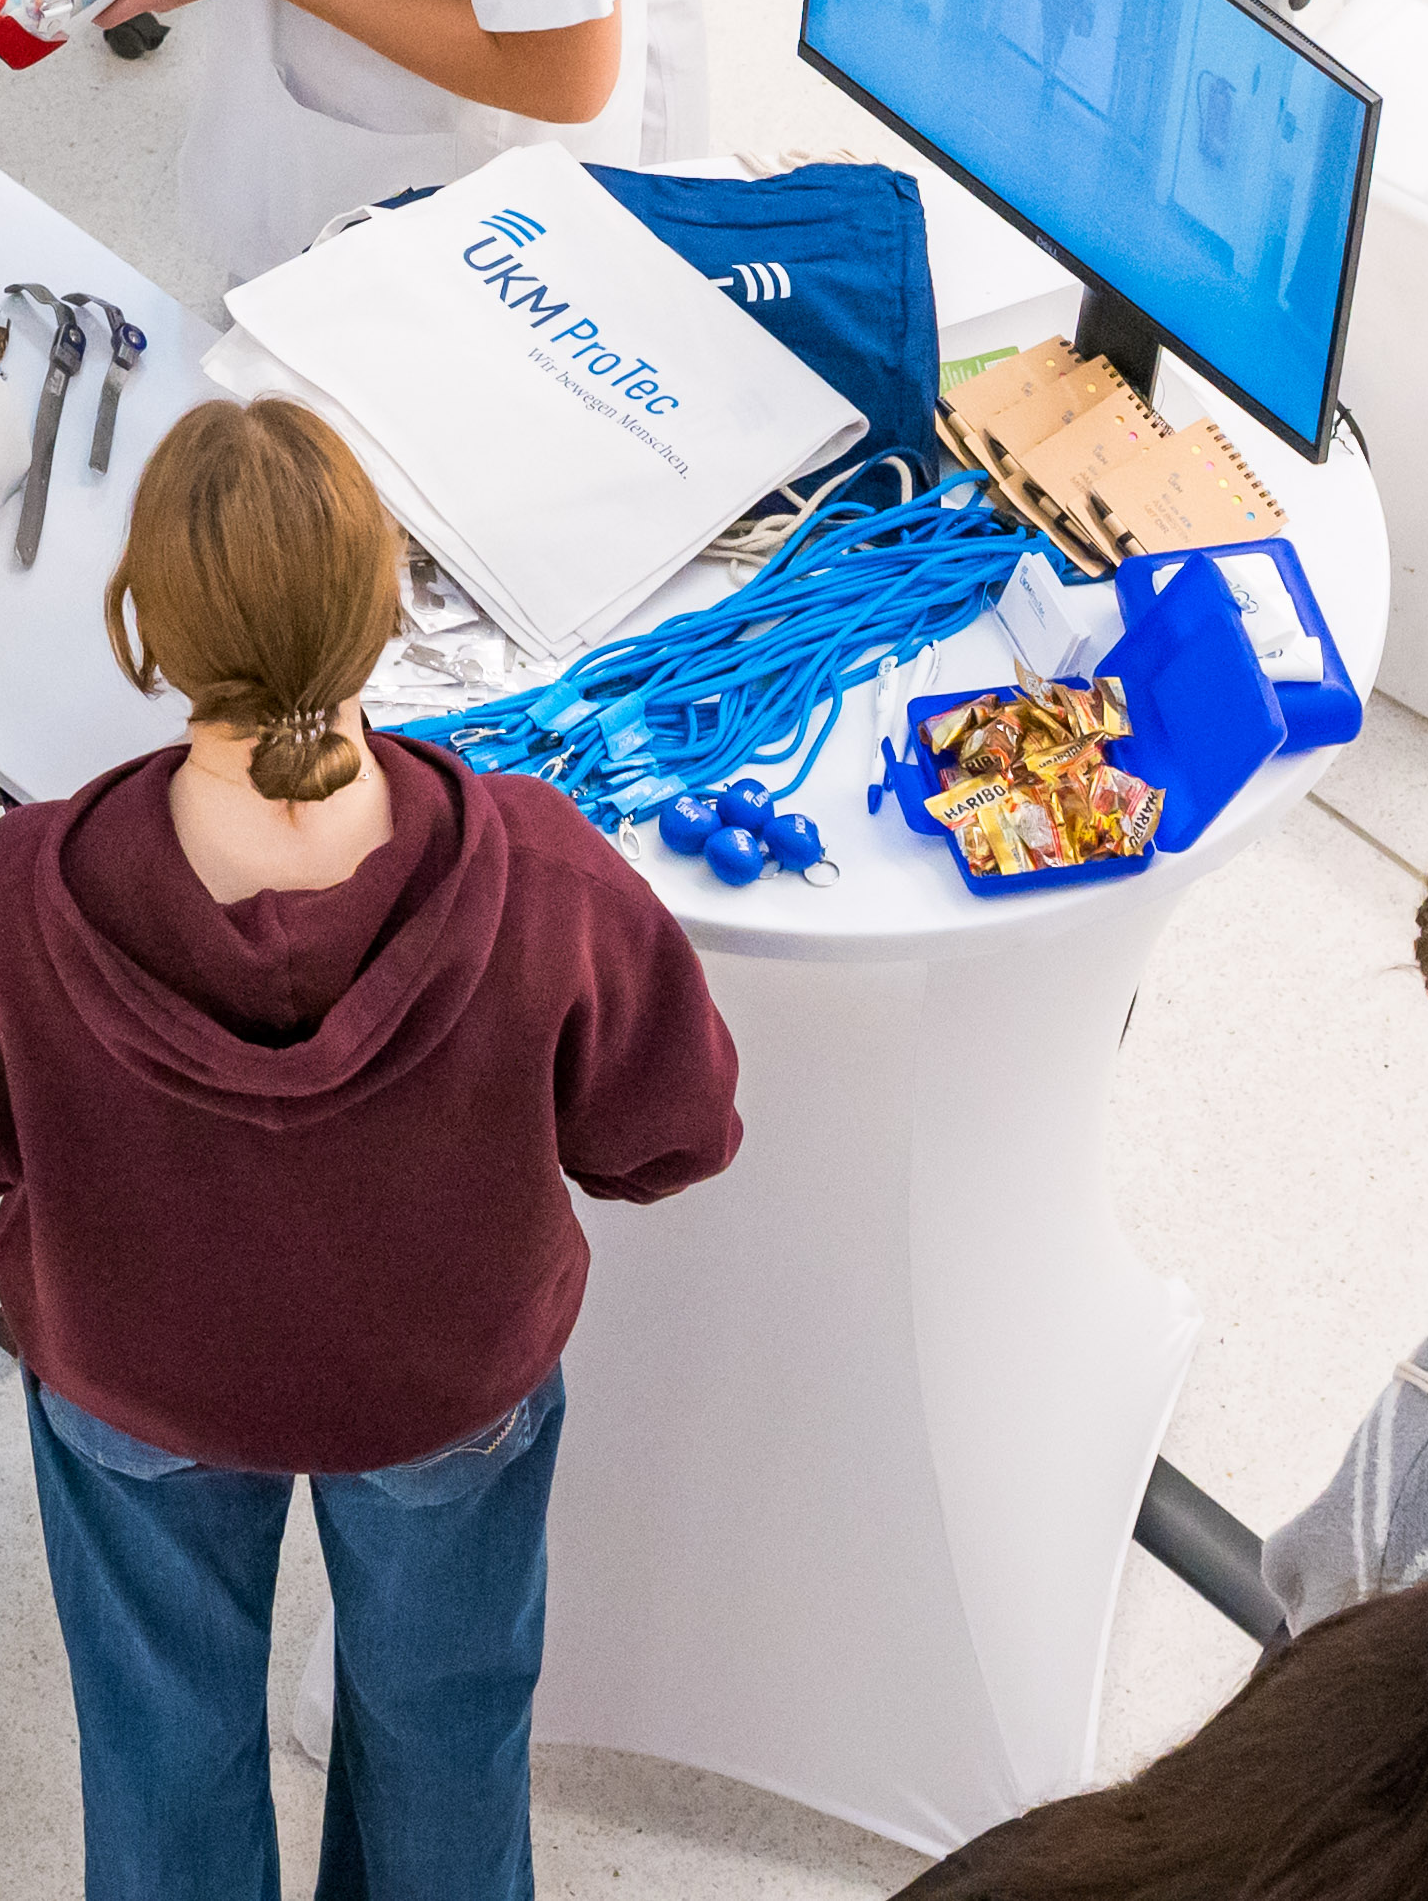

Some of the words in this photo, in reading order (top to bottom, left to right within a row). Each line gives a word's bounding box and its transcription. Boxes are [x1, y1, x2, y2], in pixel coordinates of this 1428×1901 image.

[463, 236, 570, 329] UKM
[550, 317, 680, 417] ProTec
[527, 345, 557, 375] Wir
[555, 365, 619, 420] bewegen
[616, 409, 691, 481] Menschen.
[674, 802, 701, 823] UKM
[944, 783, 1007, 820] HARIBO
[1128, 790, 1160, 849] HARIBO
